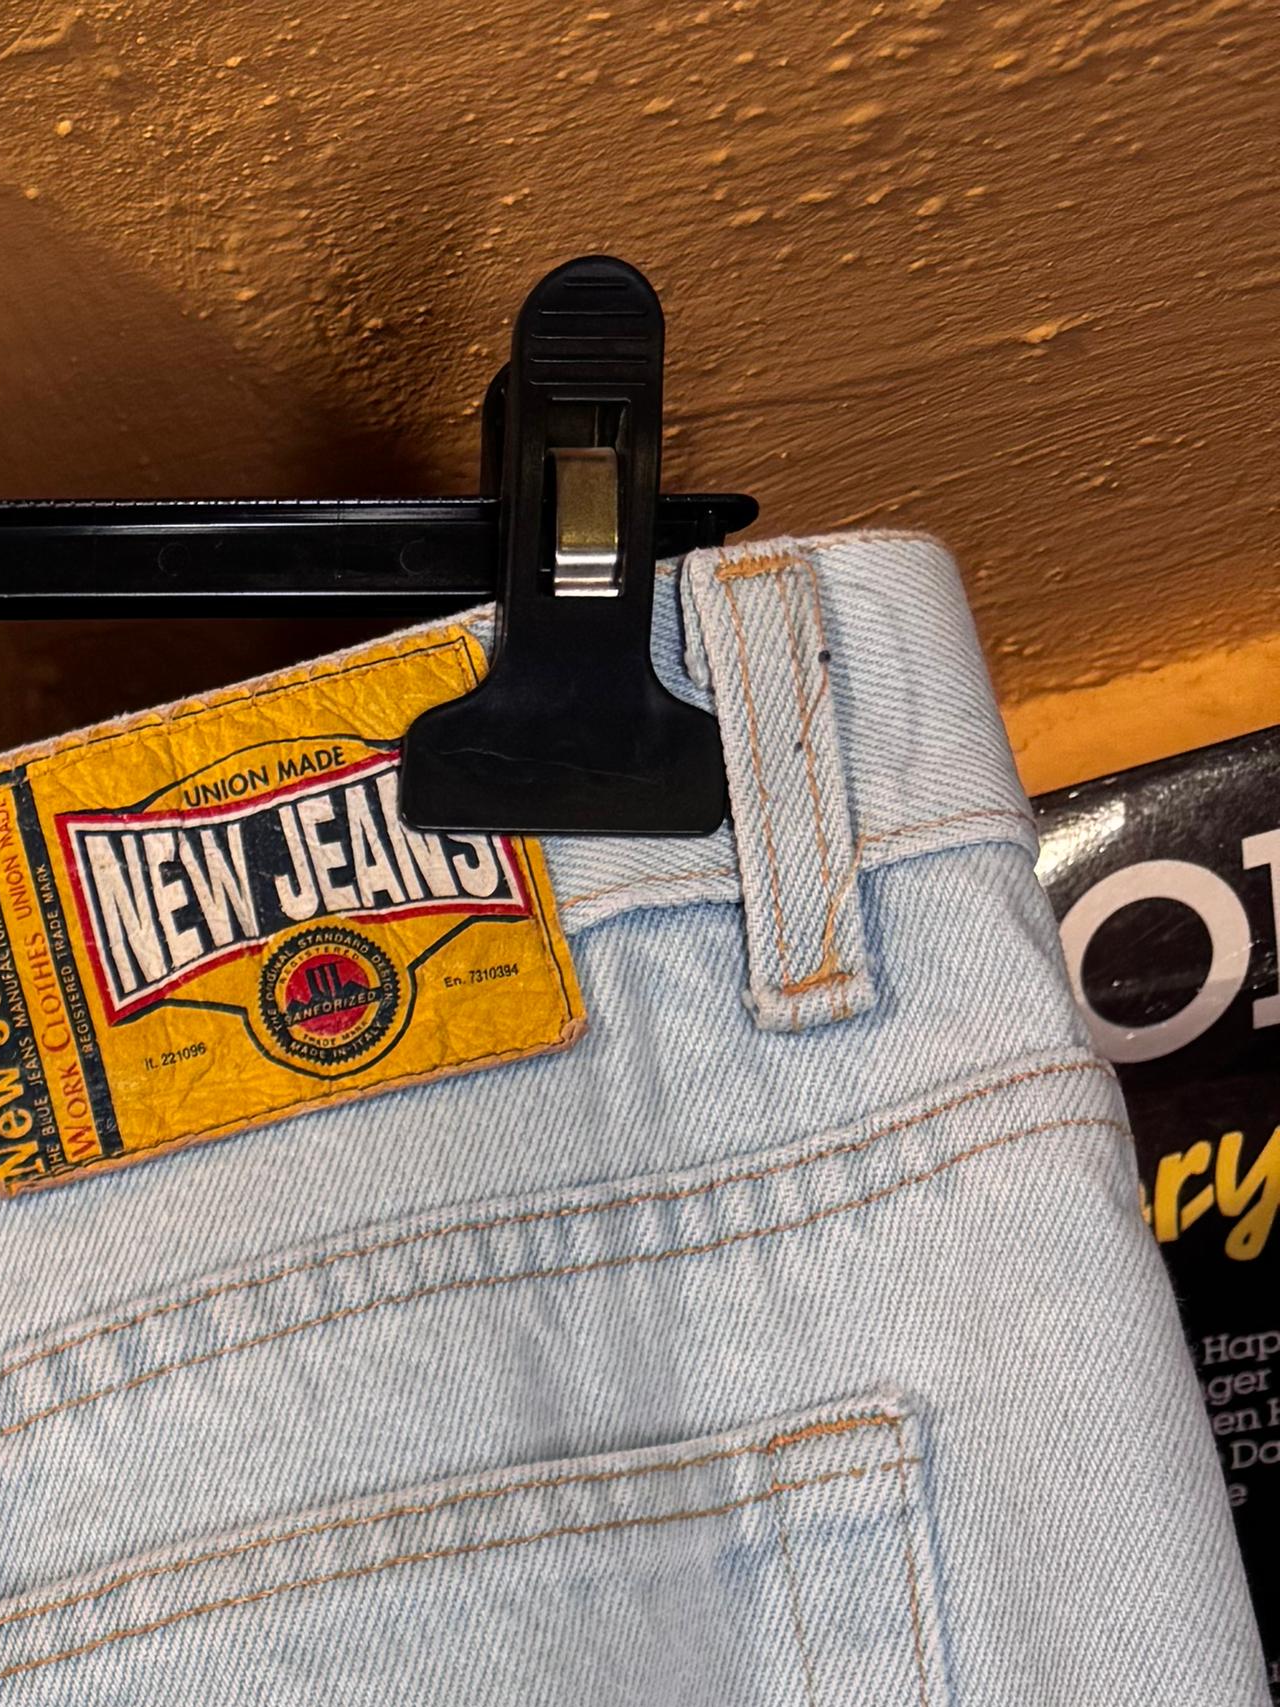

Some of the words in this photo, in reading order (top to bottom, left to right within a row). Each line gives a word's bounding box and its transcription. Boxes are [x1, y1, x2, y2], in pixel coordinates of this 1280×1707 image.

[184, 767, 269, 809] UNION
[276, 745, 346, 777] MADE
[1, 854, 33, 920] UNION
[36, 863, 54, 903] MARK
[83, 823, 261, 995] NEW
[274, 770, 502, 922] JEANS
[47, 911, 68, 959] TRADE
[267, 1007, 283, 1031] THE
[297, 933, 370, 954] STANDARD
[280, 946, 360, 984] REGISTERED
[24, 932, 71, 1052] CLOTHES
[60, 965, 94, 1057] REGISTERED
[285, 991, 376, 1021] SANFORIZED
[290, 1041, 326, 1059] MADE
[303, 1033, 337, 1046] TRADE
[342, 1021, 368, 1040] MARK
[19, 1036, 44, 1086] JEANS
[34, 1096, 56, 1137] BLUE
[59, 1061, 96, 1159] WORK
[46, 1143, 64, 1172] THE
[1140, 1125, 1280, 1262] ry
